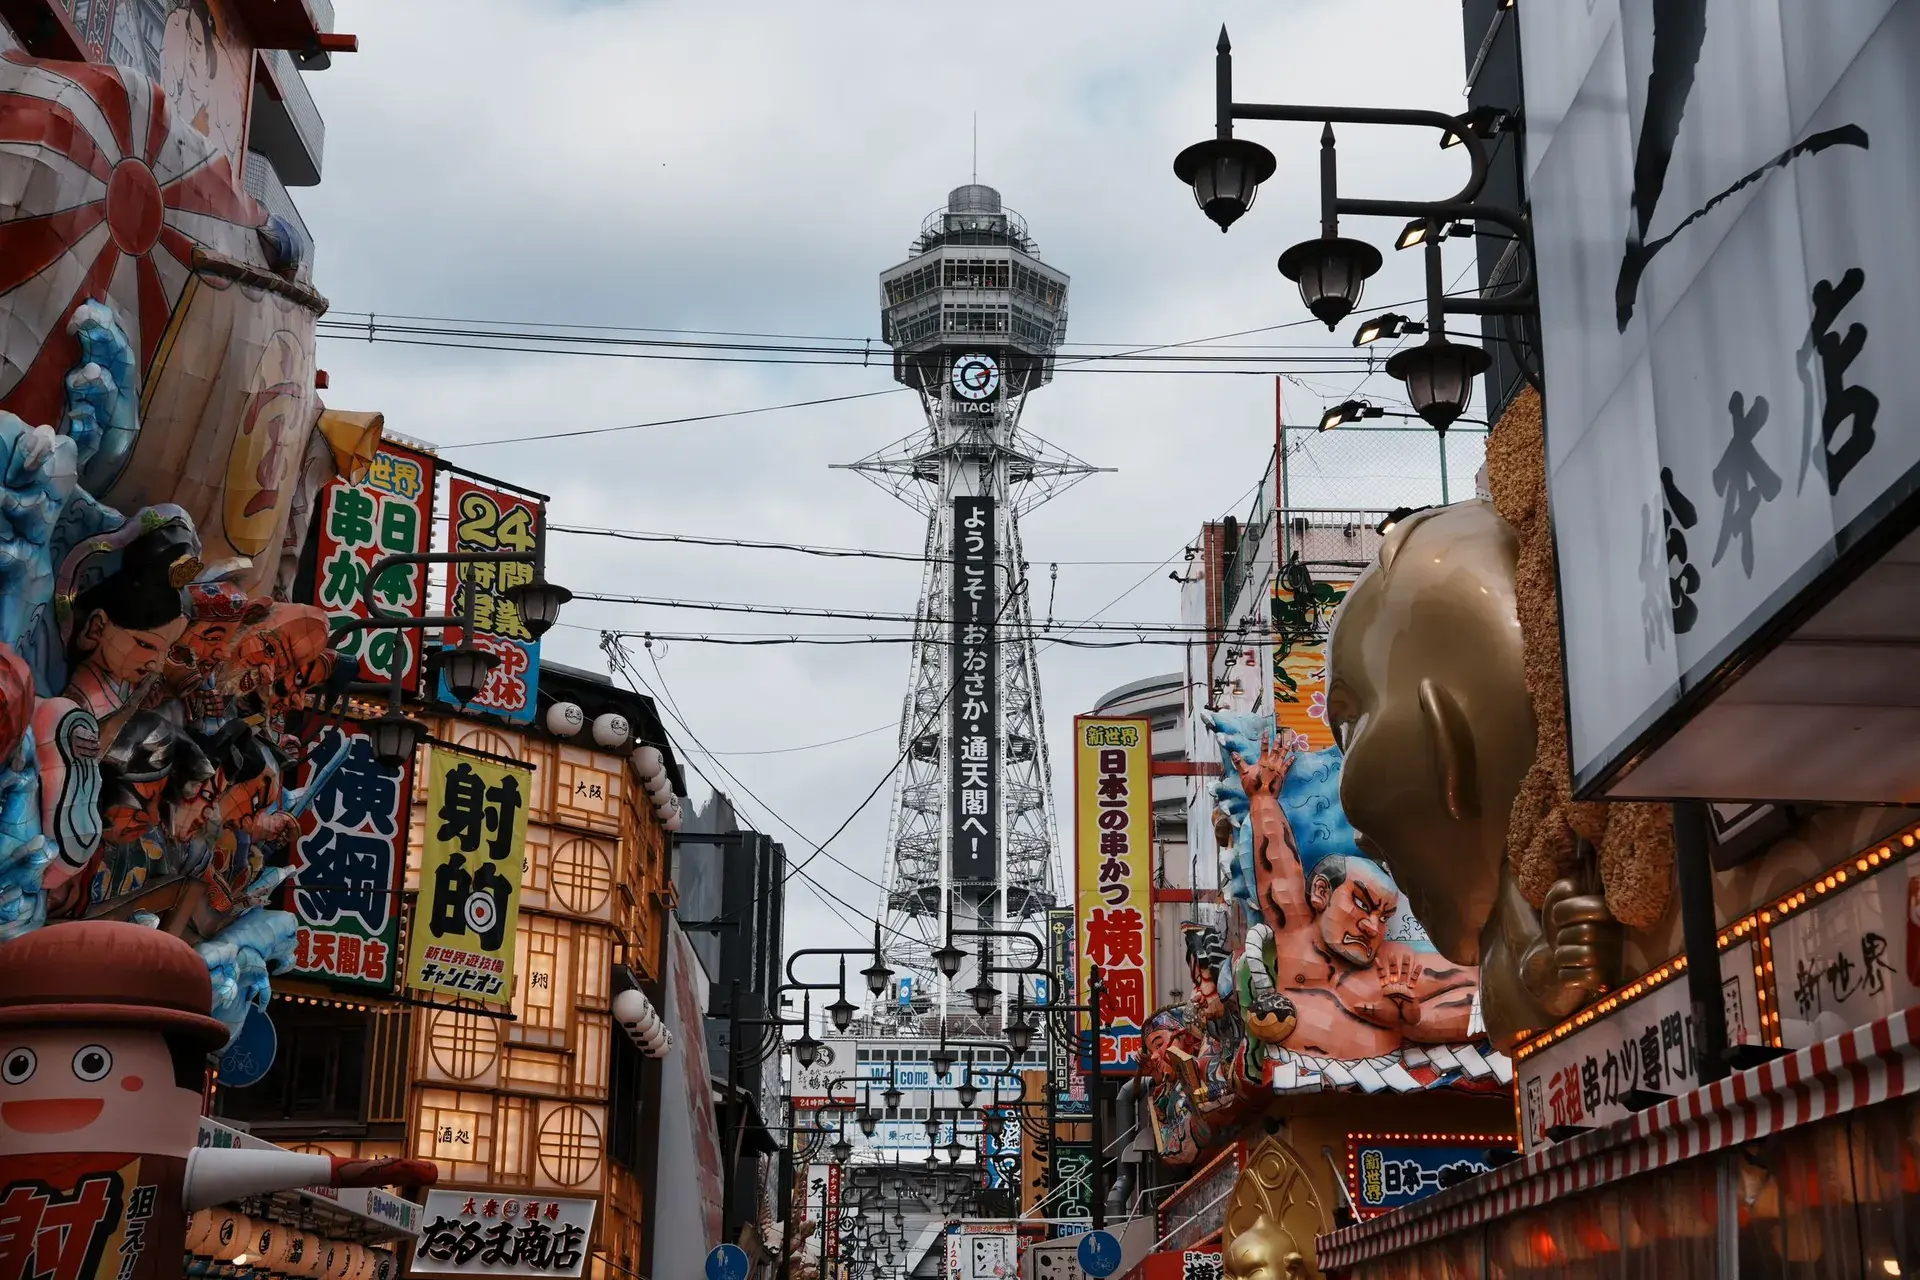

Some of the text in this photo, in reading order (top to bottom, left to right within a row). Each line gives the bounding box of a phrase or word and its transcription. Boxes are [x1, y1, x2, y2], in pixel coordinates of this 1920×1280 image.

[945, 402, 1006, 413] HITACH
[362, 453, 420, 499] 世界
[459, 495, 536, 555] 24
[1087, 726, 1138, 747] 新世界
[574, 781, 603, 801] 大阪
[296, 731, 399, 931] 横綱
[1098, 749, 1131, 906] 日本一の串かつ
[429, 762, 521, 950] 射的
[421, 963, 505, 995] チャンピオン
[425, 945, 504, 974] 新世界遊技場
[1087, 908, 1145, 1028] 横綱
[438, 1125, 470, 1145] 酒処
[1365, 1151, 1383, 1202] 新世界
[417, 1216, 585, 1270] だるま商店
[1185, 1252, 1221, 1262] 日本一の
